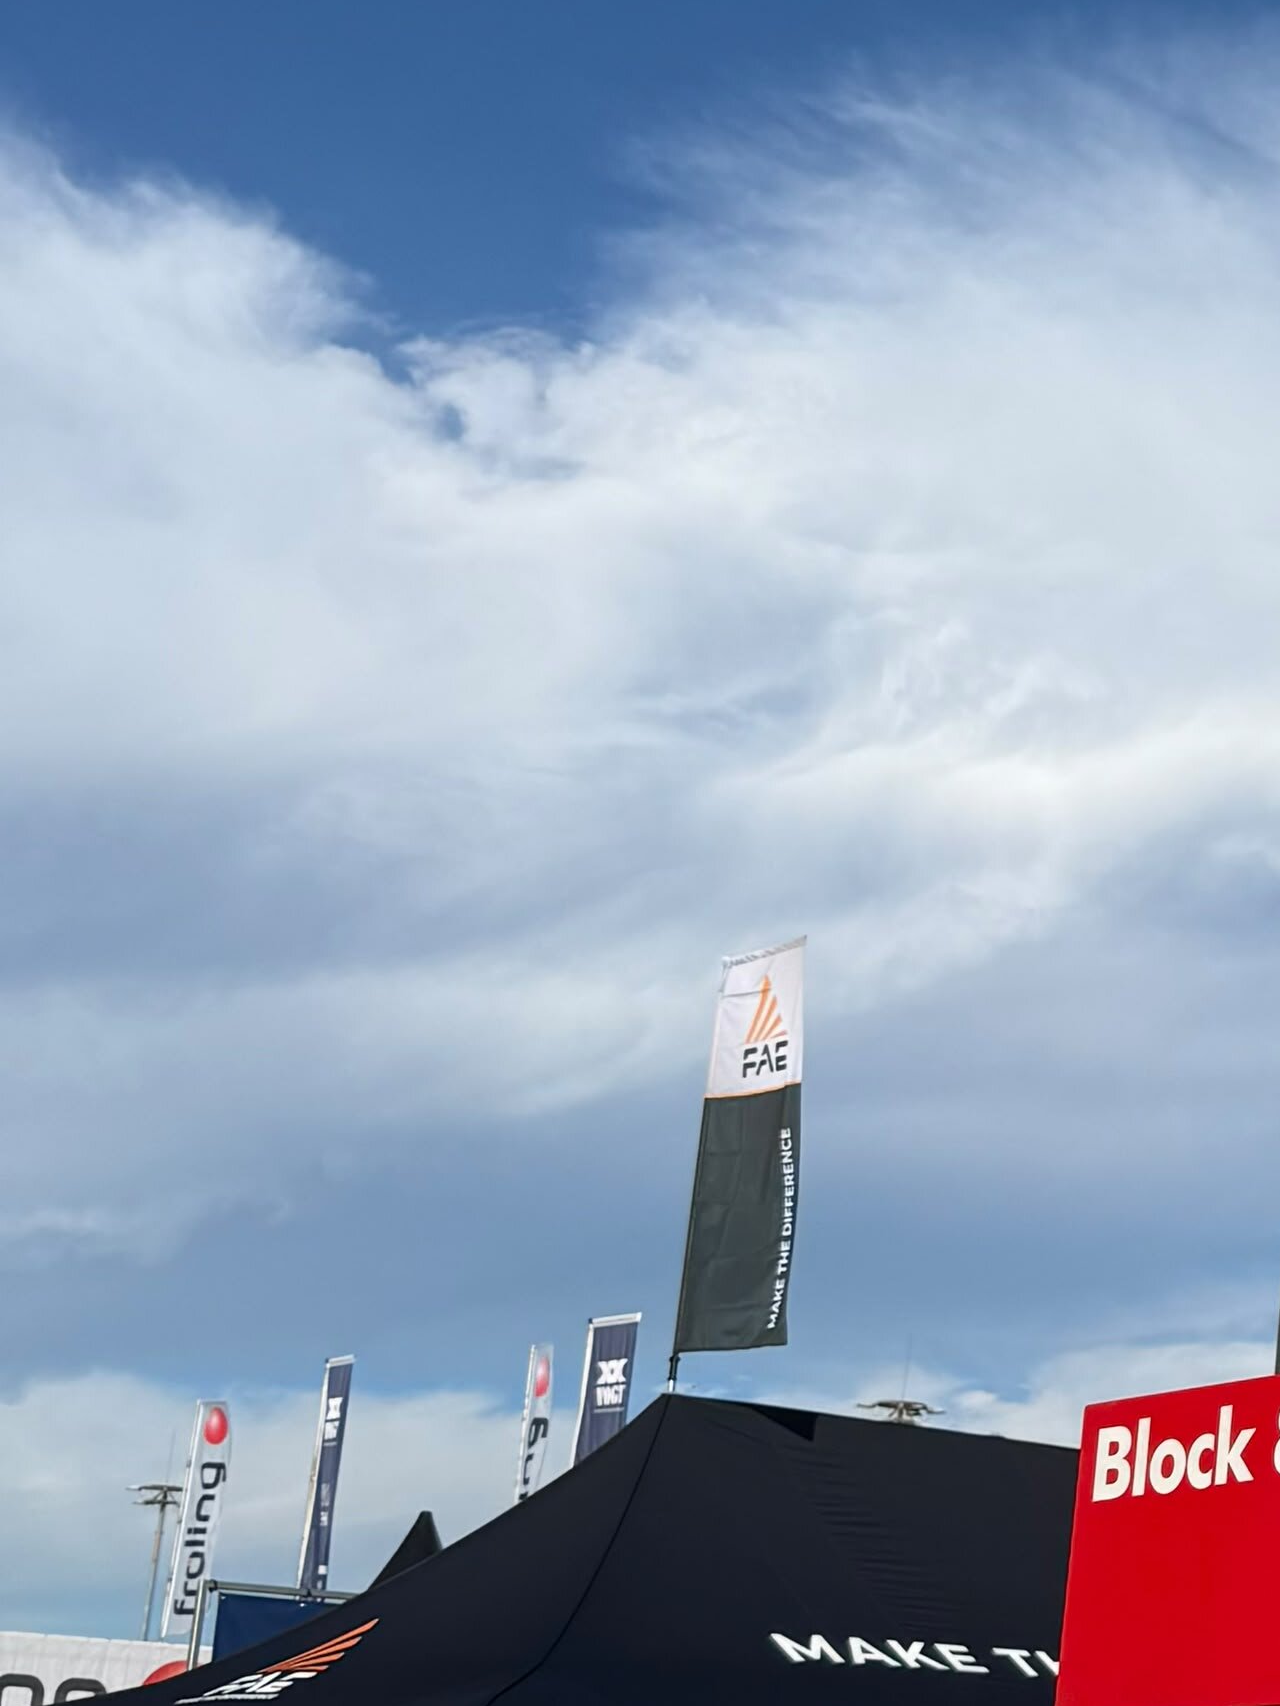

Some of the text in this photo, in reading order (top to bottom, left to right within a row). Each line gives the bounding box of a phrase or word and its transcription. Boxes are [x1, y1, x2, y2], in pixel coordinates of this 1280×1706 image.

[742, 1039, 789, 1079] FAE
[767, 1127, 795, 1330] MAKE THE DIFFERENCE
[1092, 1404, 1257, 1503] Block
[768, 1632, 991, 1674] MAKE
